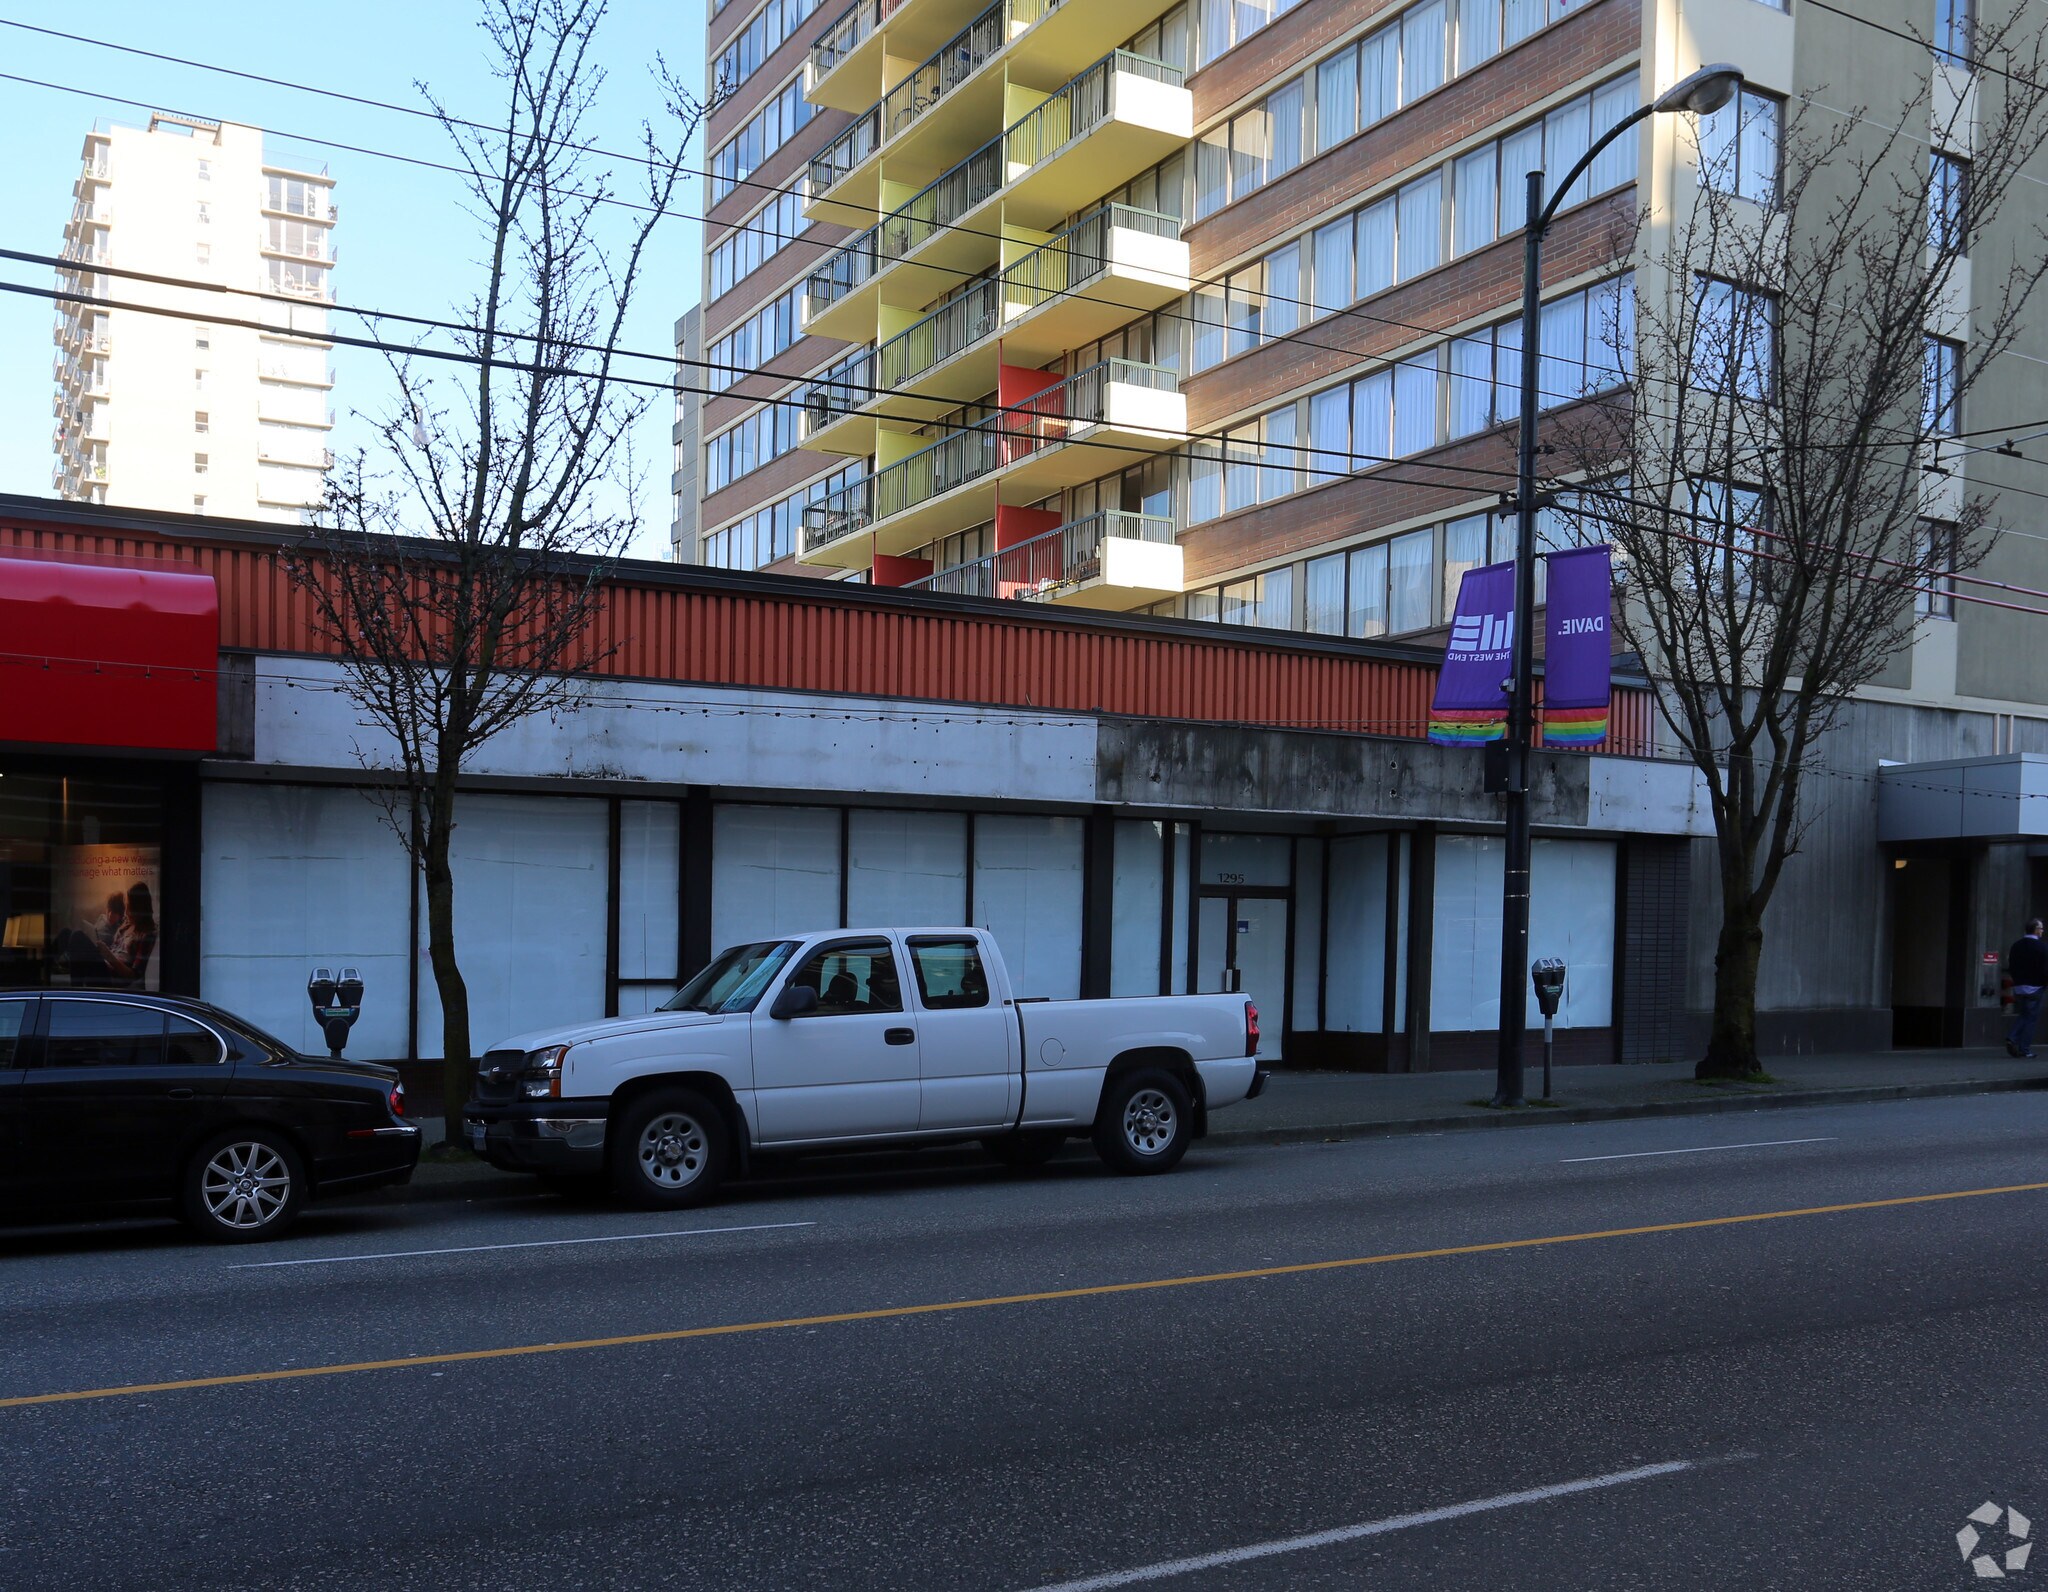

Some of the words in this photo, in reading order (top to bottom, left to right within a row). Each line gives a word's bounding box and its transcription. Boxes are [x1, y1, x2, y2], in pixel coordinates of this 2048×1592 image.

[106, 856, 112, 864] a
[112, 855, 129, 864] new
[130, 854, 146, 866] way
[101, 866, 122, 877] what
[123, 865, 154, 877] matters
[1217, 872, 1245, 884] 1295
